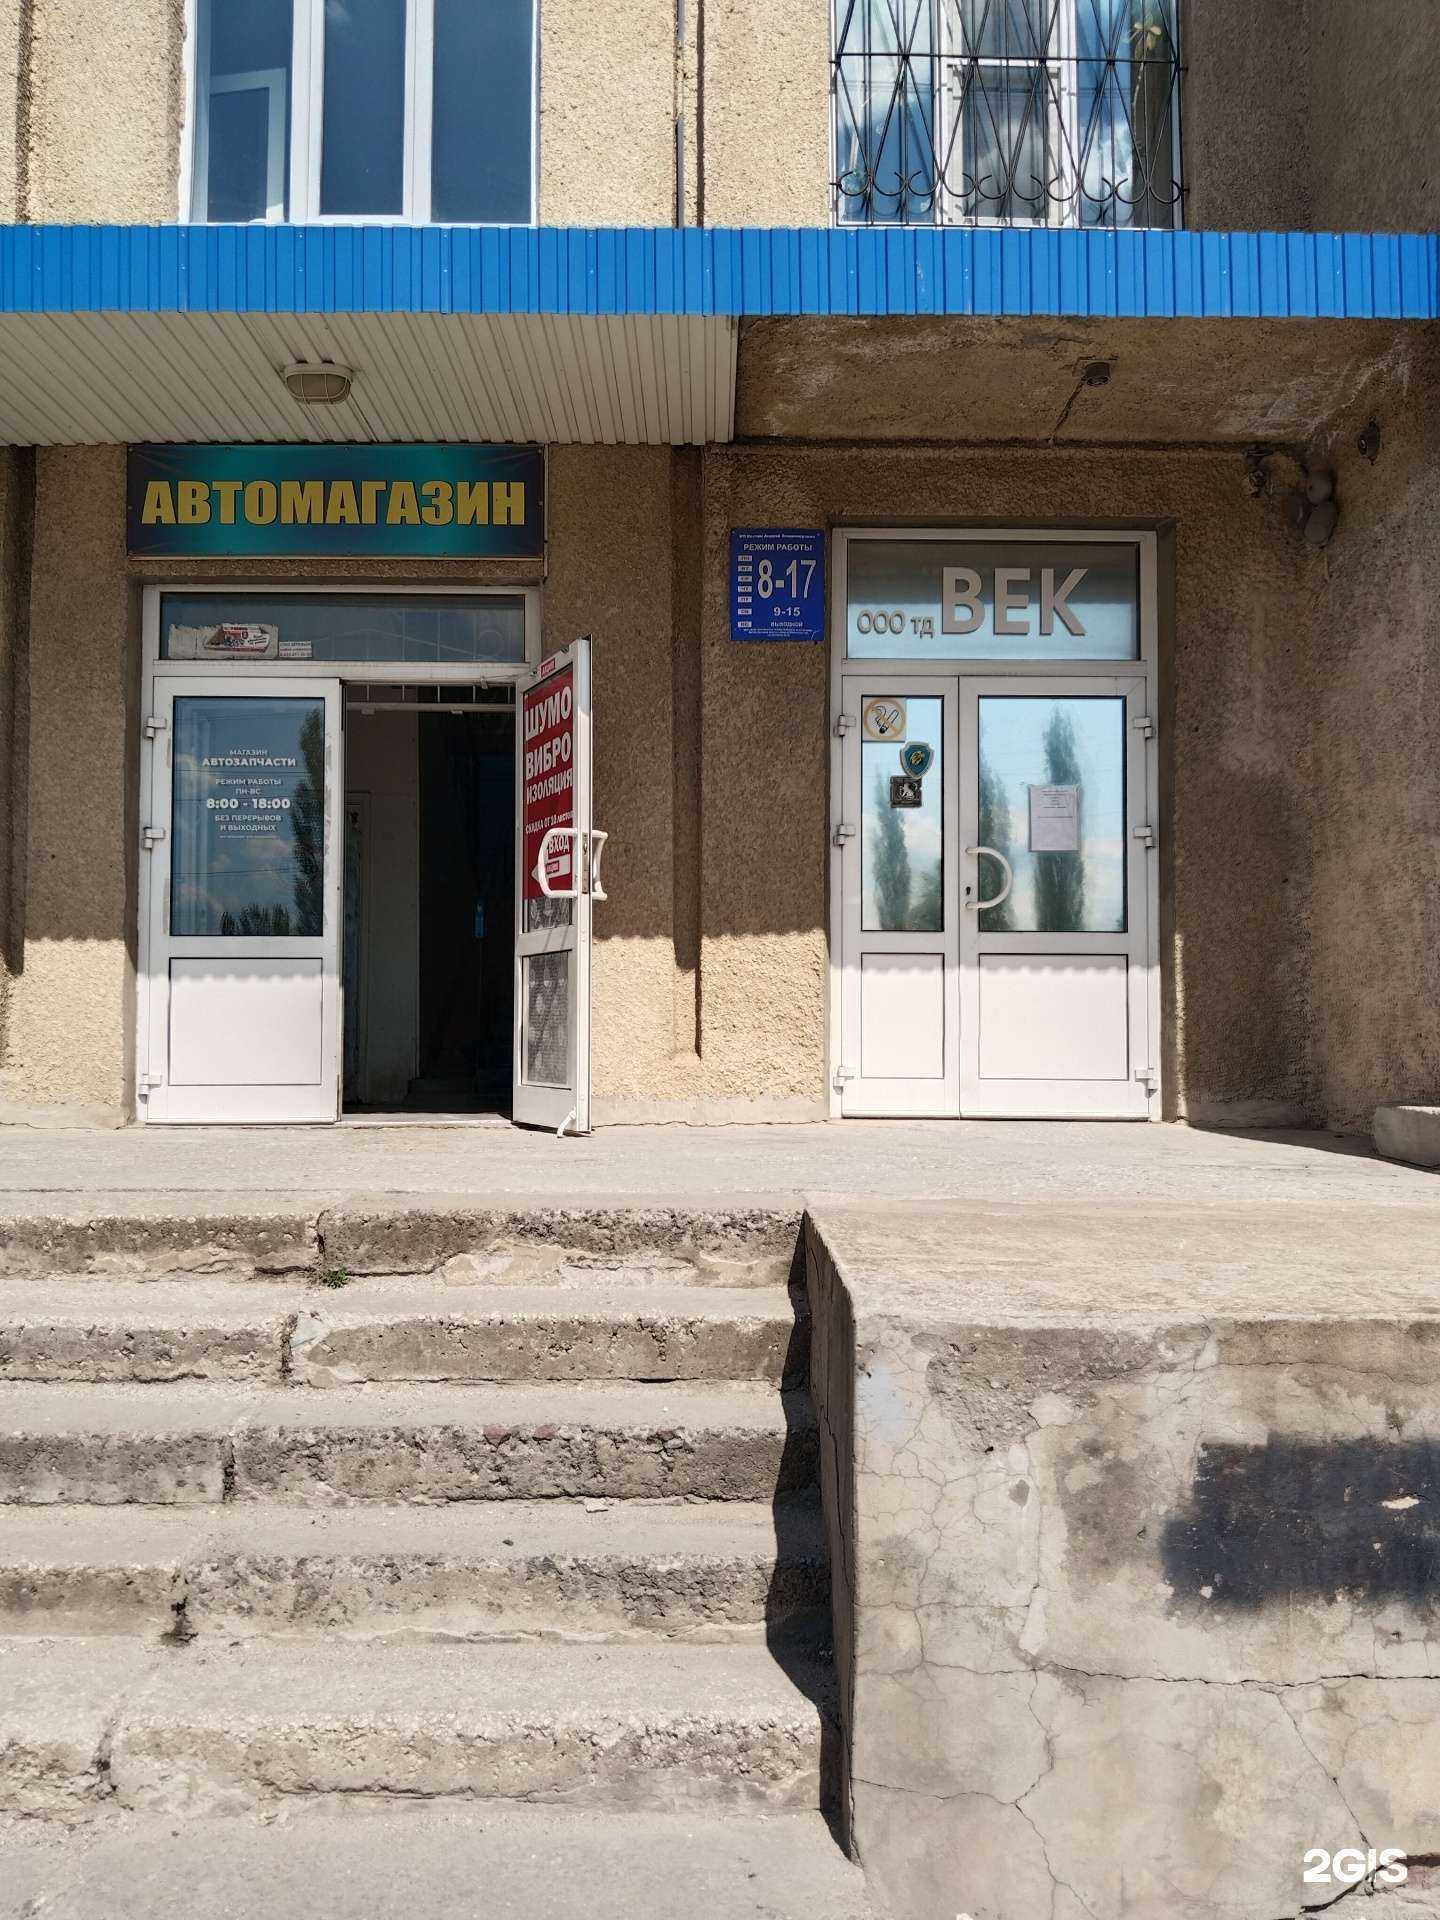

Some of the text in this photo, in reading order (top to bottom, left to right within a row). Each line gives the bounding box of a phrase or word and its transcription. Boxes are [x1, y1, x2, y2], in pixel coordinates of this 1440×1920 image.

[141, 480, 526, 526] АВТОМАГАЗИН
[743, 543, 813, 551] РЕЖИМ РАБОТЫ
[757, 559, 817, 599] 8-17
[773, 606, 801, 617] 9-15
[857, 609, 906, 635] ООО
[941, 566, 1089, 636] ВЕК
[525, 686, 572, 741] ШУМО
[202, 757, 296, 766] АВТОЗАПЧАСТИ
[525, 731, 572, 780] ВИБРО
[526, 768, 573, 805] ИЗОЛЯЦИЯ
[206, 798, 239, 809] 8:00
[252, 798, 291, 809] 18:00
[228, 824, 276, 832] ВЫХОДНЫХ
[548, 833, 570, 855] ВХОД
